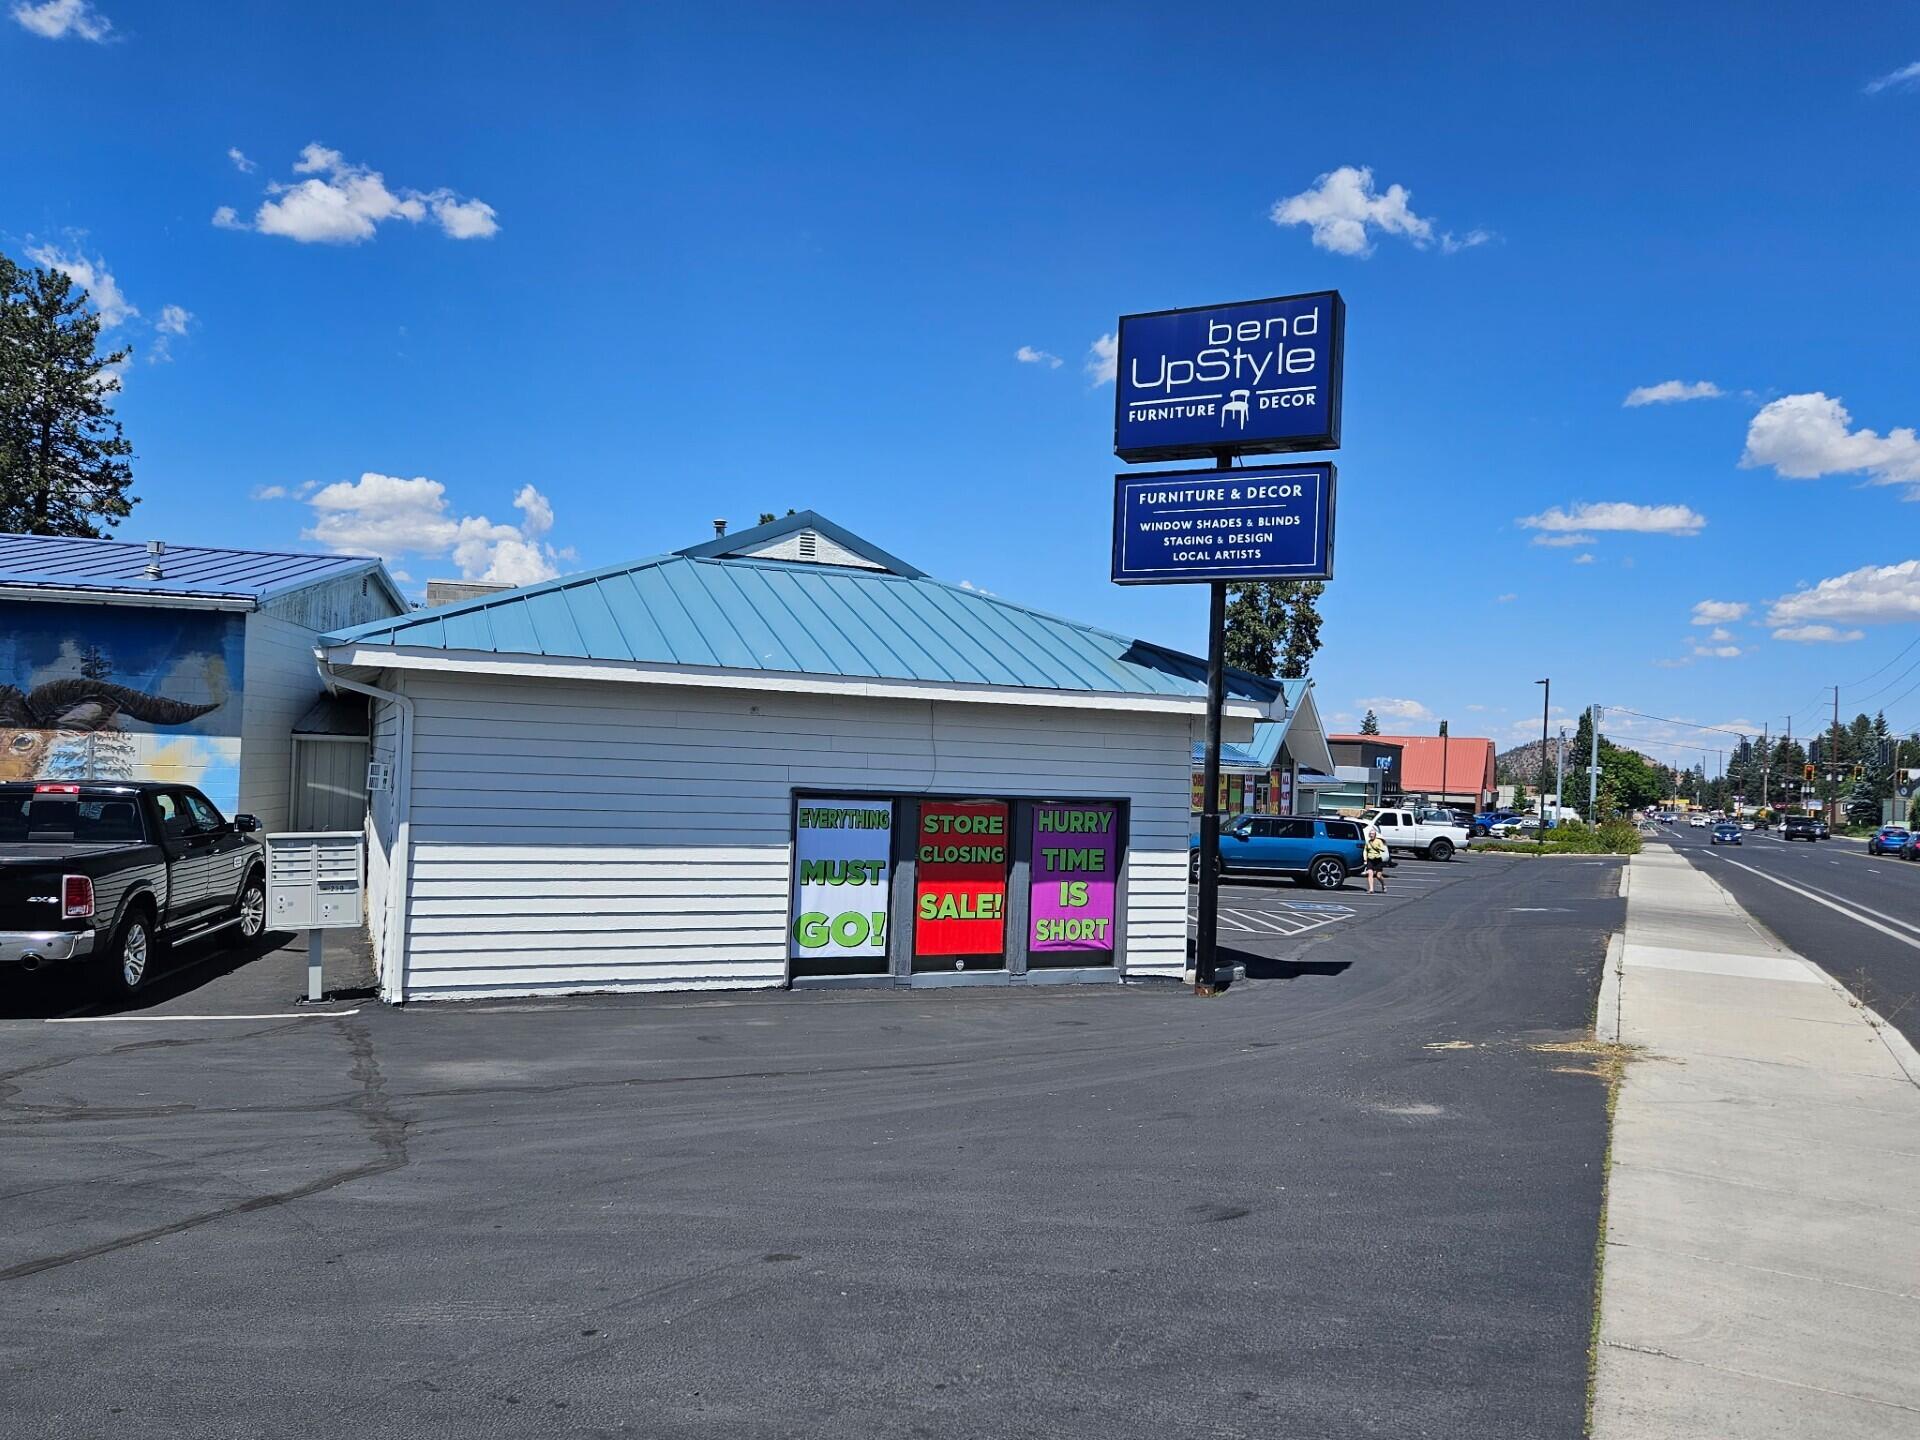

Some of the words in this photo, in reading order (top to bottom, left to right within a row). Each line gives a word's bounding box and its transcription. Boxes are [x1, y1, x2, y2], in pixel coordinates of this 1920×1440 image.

[1208, 306, 1319, 346] bend
[1132, 342, 1316, 393] UpStyle
[1128, 403, 1216, 423] FURNITURE
[1258, 393, 1317, 410] DECOR
[1138, 488, 1225, 505] FURNITURE
[1230, 488, 1241, 500] &
[1246, 484, 1303, 499] DECOR
[1139, 520, 1193, 532] WINDOW
[1196, 517, 1242, 530] SHADES
[1246, 518, 1253, 528] &
[1257, 515, 1301, 527] BLINDS
[1163, 534, 1213, 547] STAGING
[1217, 535, 1224, 545] &
[1228, 532, 1273, 545] DESIGN
[1173, 551, 1211, 562] LOCAL
[1214, 549, 1262, 561] ARTISTS
[799, 807, 890, 830] EVERYTHING
[923, 815, 1005, 836] STORE
[1037, 809, 1113, 834] HURRY
[919, 846, 1005, 864] CLOSING
[1041, 848, 1106, 872] TIME
[800, 859, 886, 887] MUST
[919, 892, 1004, 921] SALE!
[1059, 880, 1090, 908] IS
[793, 911, 887, 948] GO!
[1035, 917, 1110, 942] SHORT
